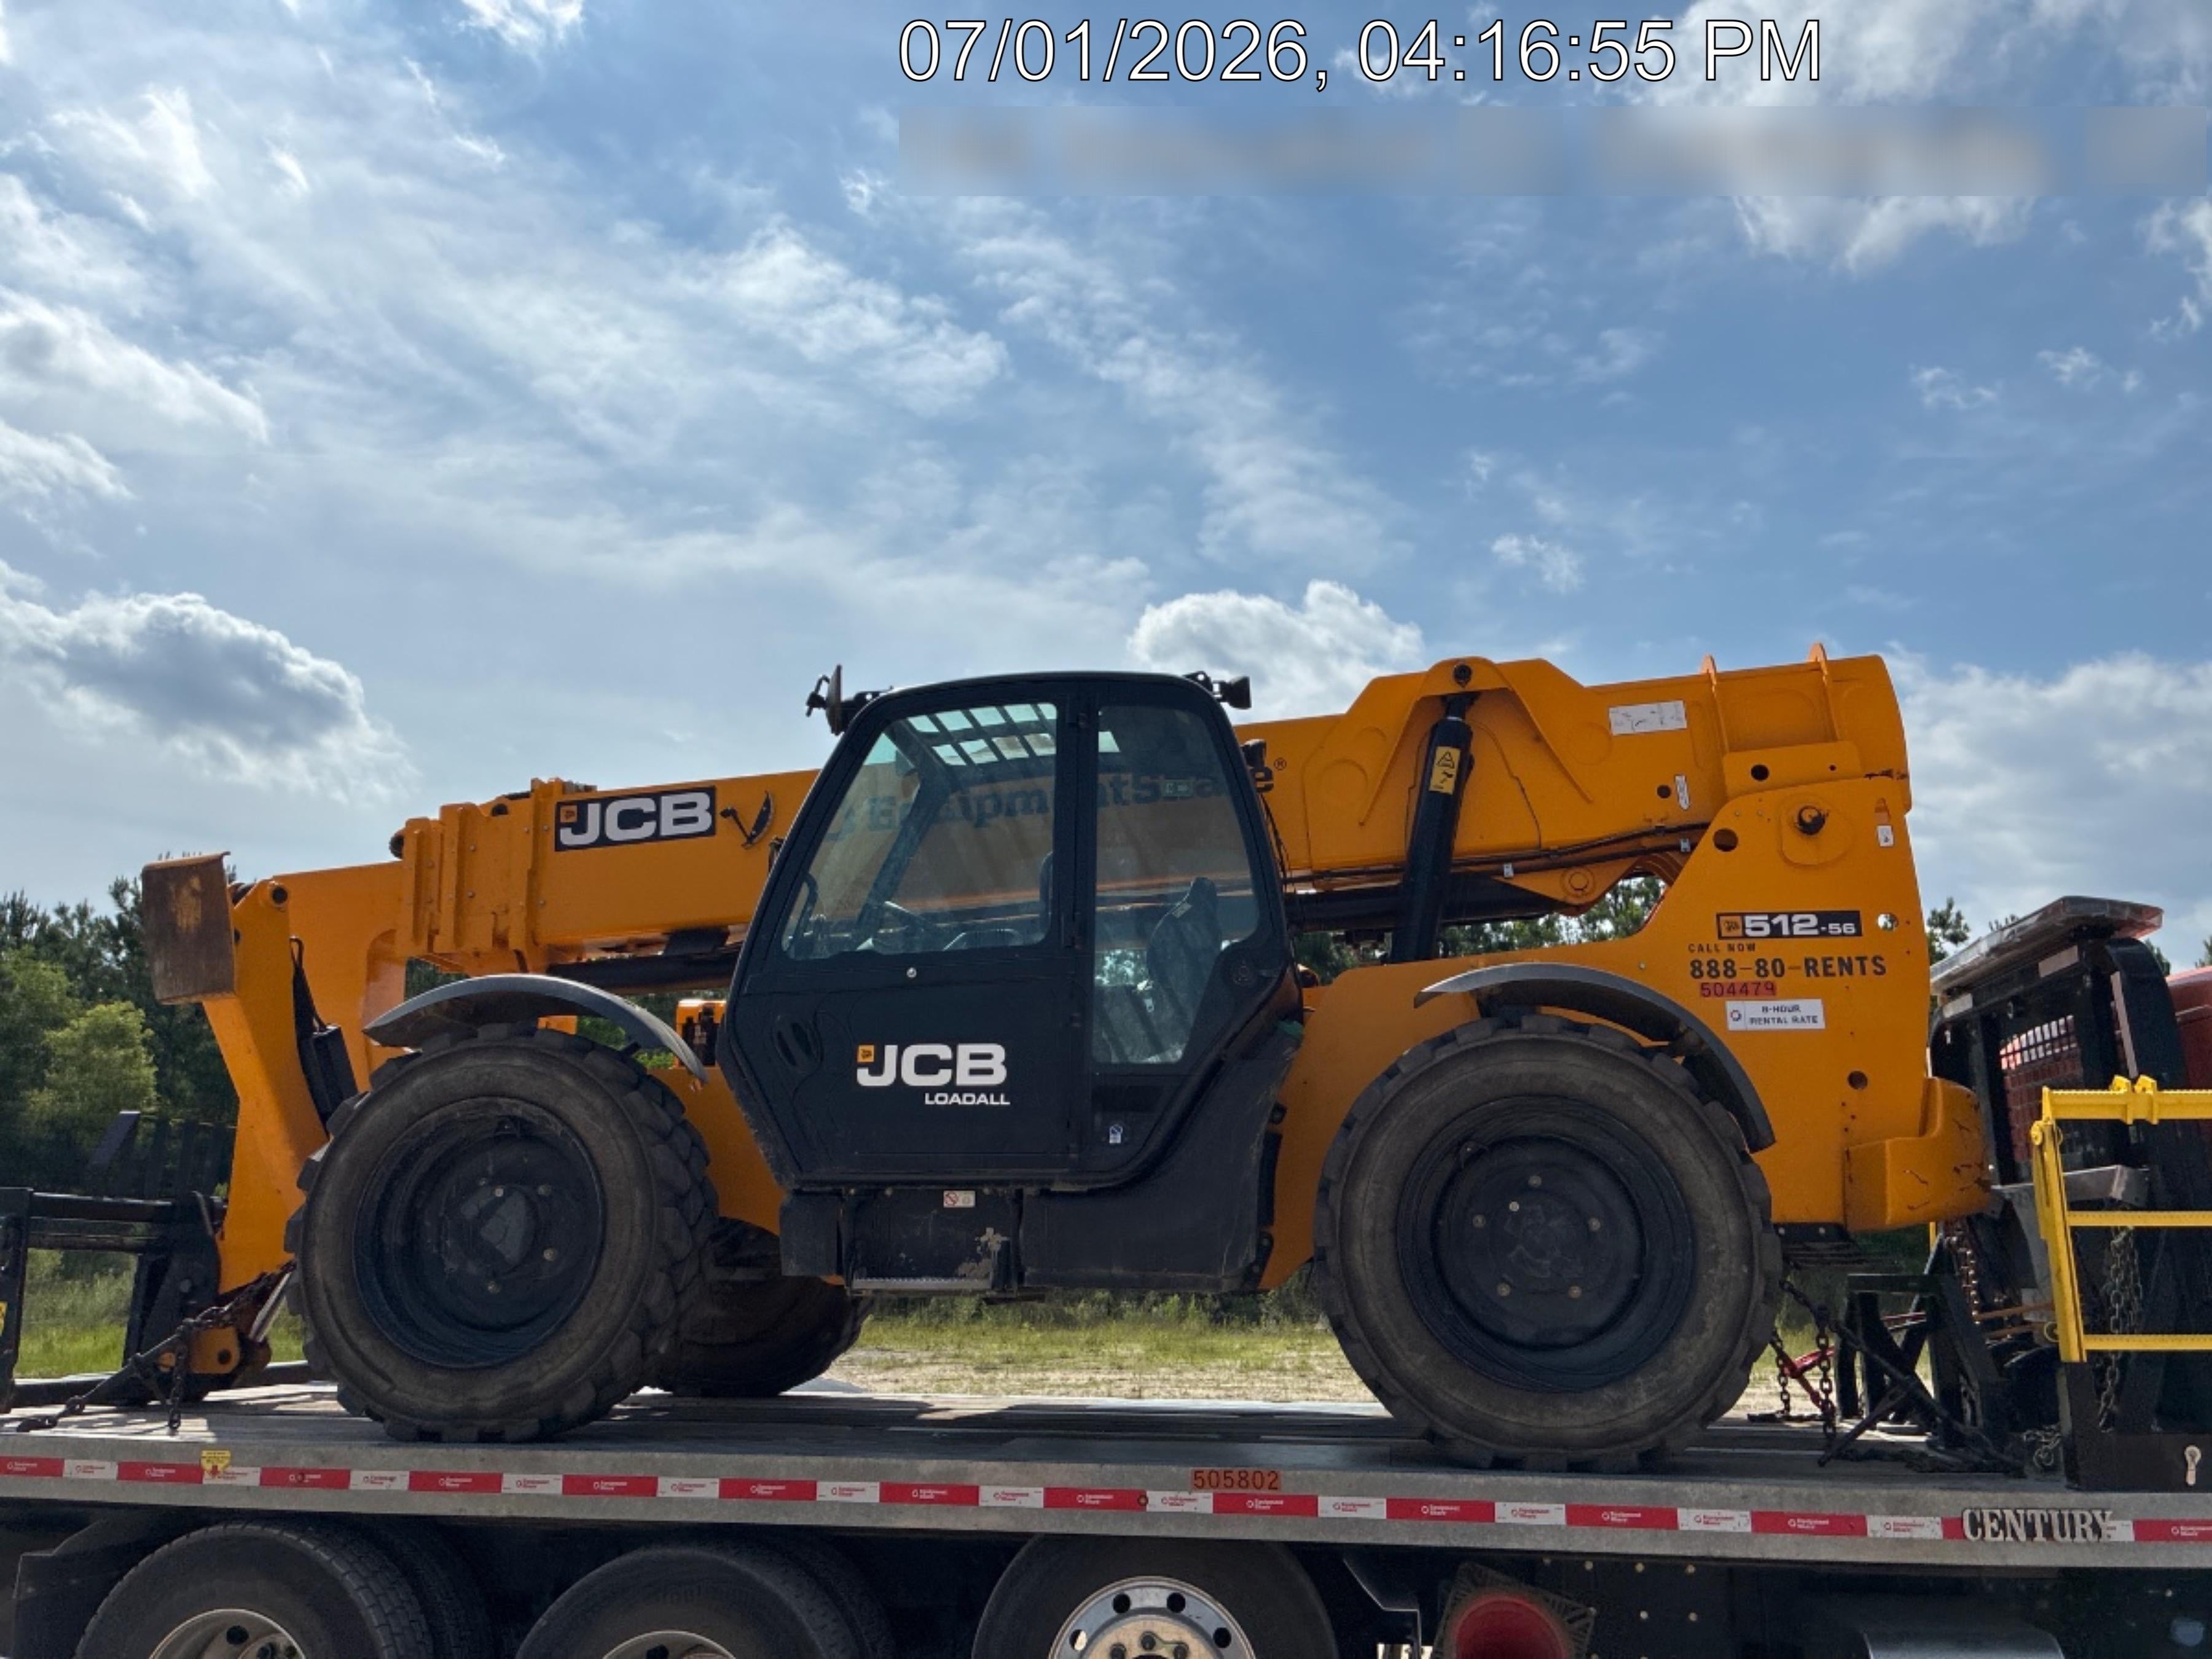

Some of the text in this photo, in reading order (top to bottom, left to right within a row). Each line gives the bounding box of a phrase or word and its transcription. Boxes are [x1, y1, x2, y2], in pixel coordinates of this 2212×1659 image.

[560, 791, 713, 846] JCB
[1744, 913, 1856, 938] 512-56
[1688, 943, 1755, 953] CALL NOW
[1690, 955, 1886, 979] 888-80-RENTS
[1700, 981, 1776, 997] 504479
[1791, 1015, 1819, 1024] RATE
[857, 1043, 1008, 1086] JCB
[924, 1092, 1011, 1105] LOADALL
[1193, 1470, 1279, 1490] 505802
[1962, 1508, 2113, 1543] CENTURY
